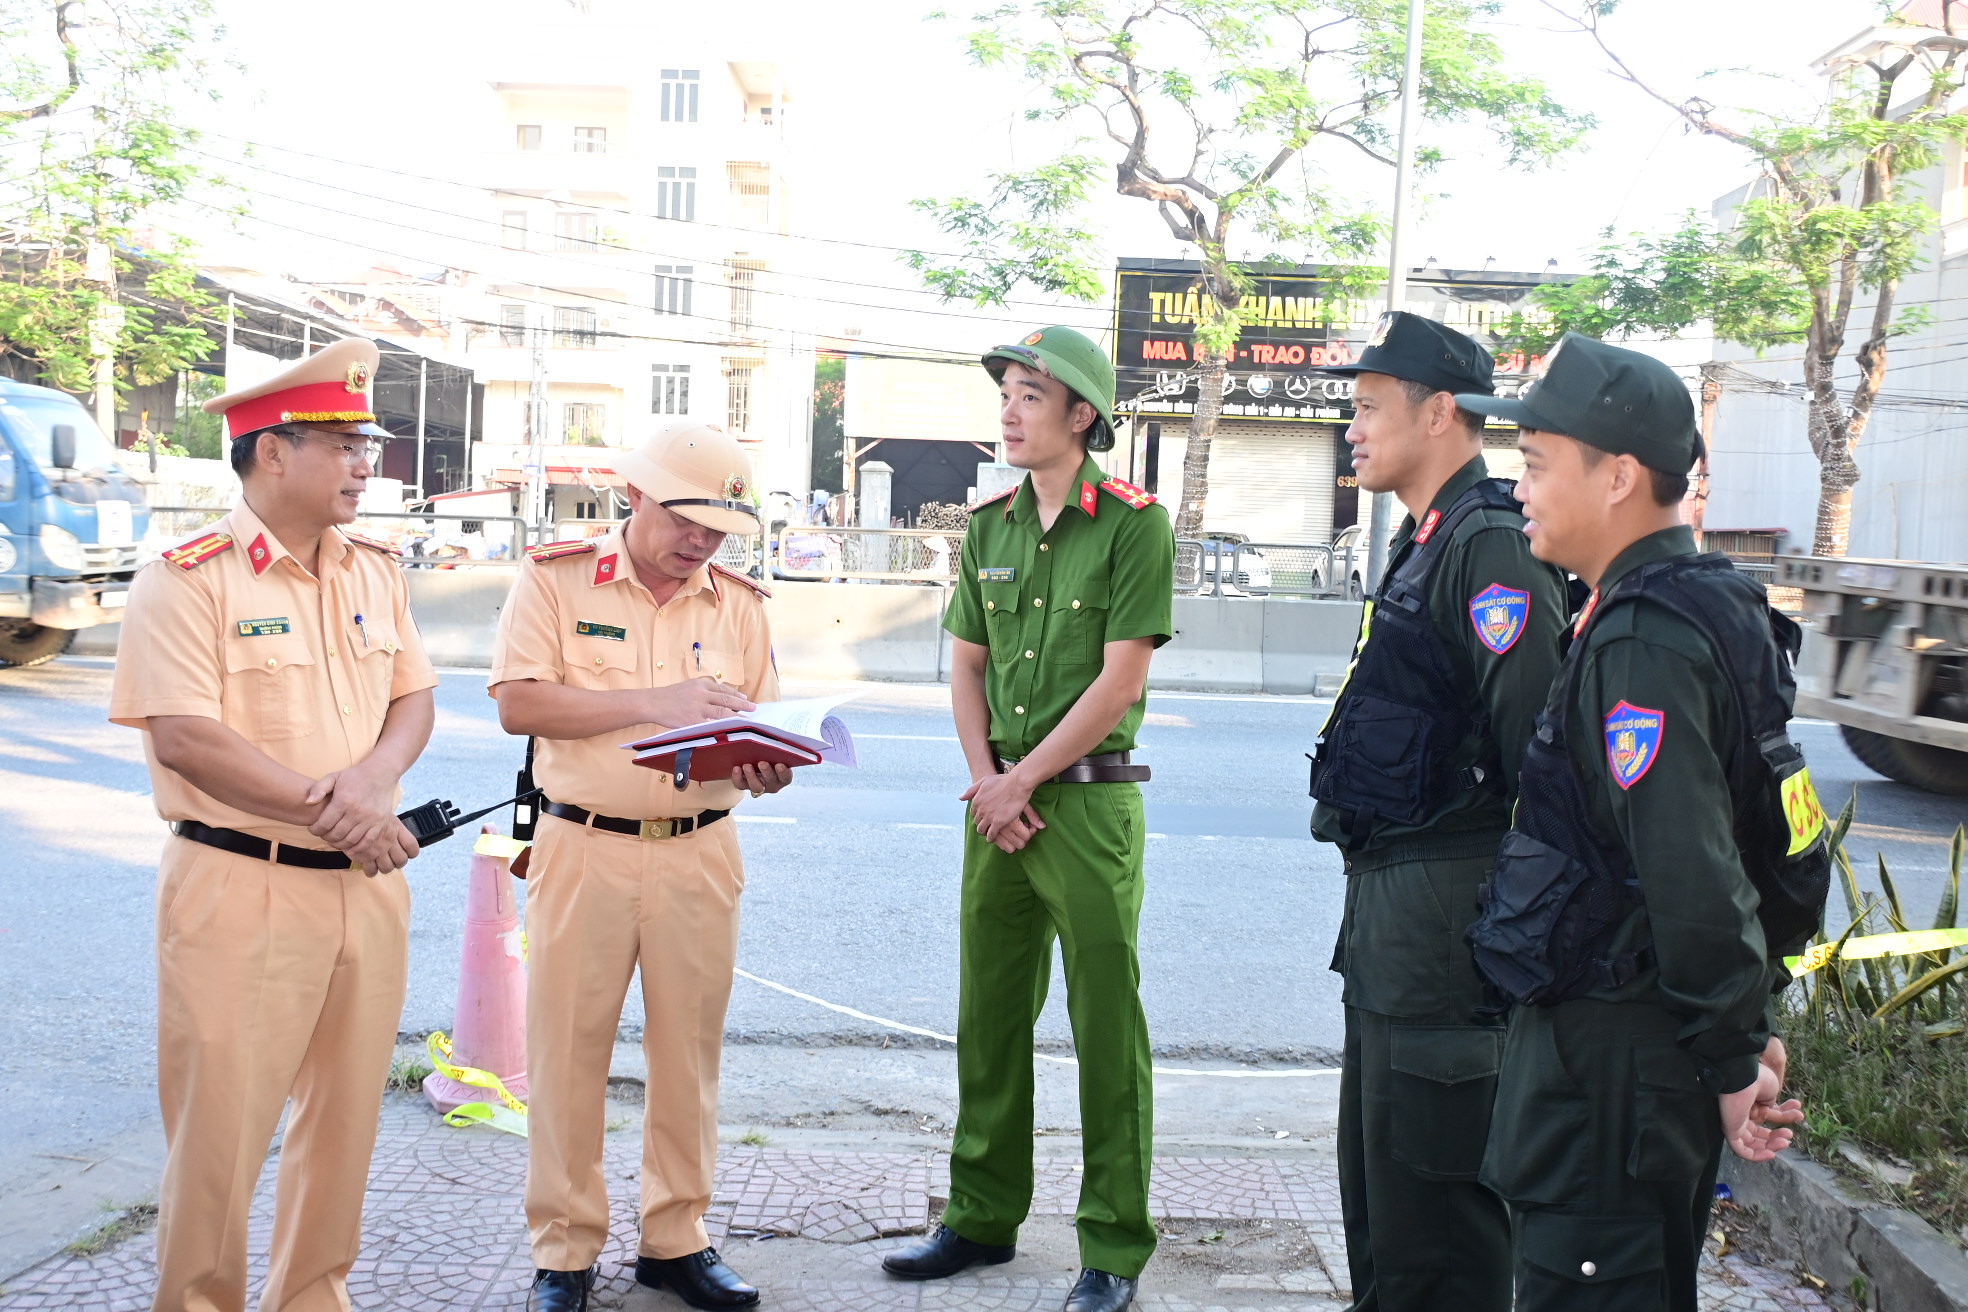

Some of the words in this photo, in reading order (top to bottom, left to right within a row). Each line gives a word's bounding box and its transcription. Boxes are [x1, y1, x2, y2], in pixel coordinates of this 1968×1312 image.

[1143, 340, 1187, 361] MUA
[1193, 343, 1235, 363] BN
[1250, 344, 1305, 365] TRAO
[1310, 337, 1351, 366] ĐỔI
